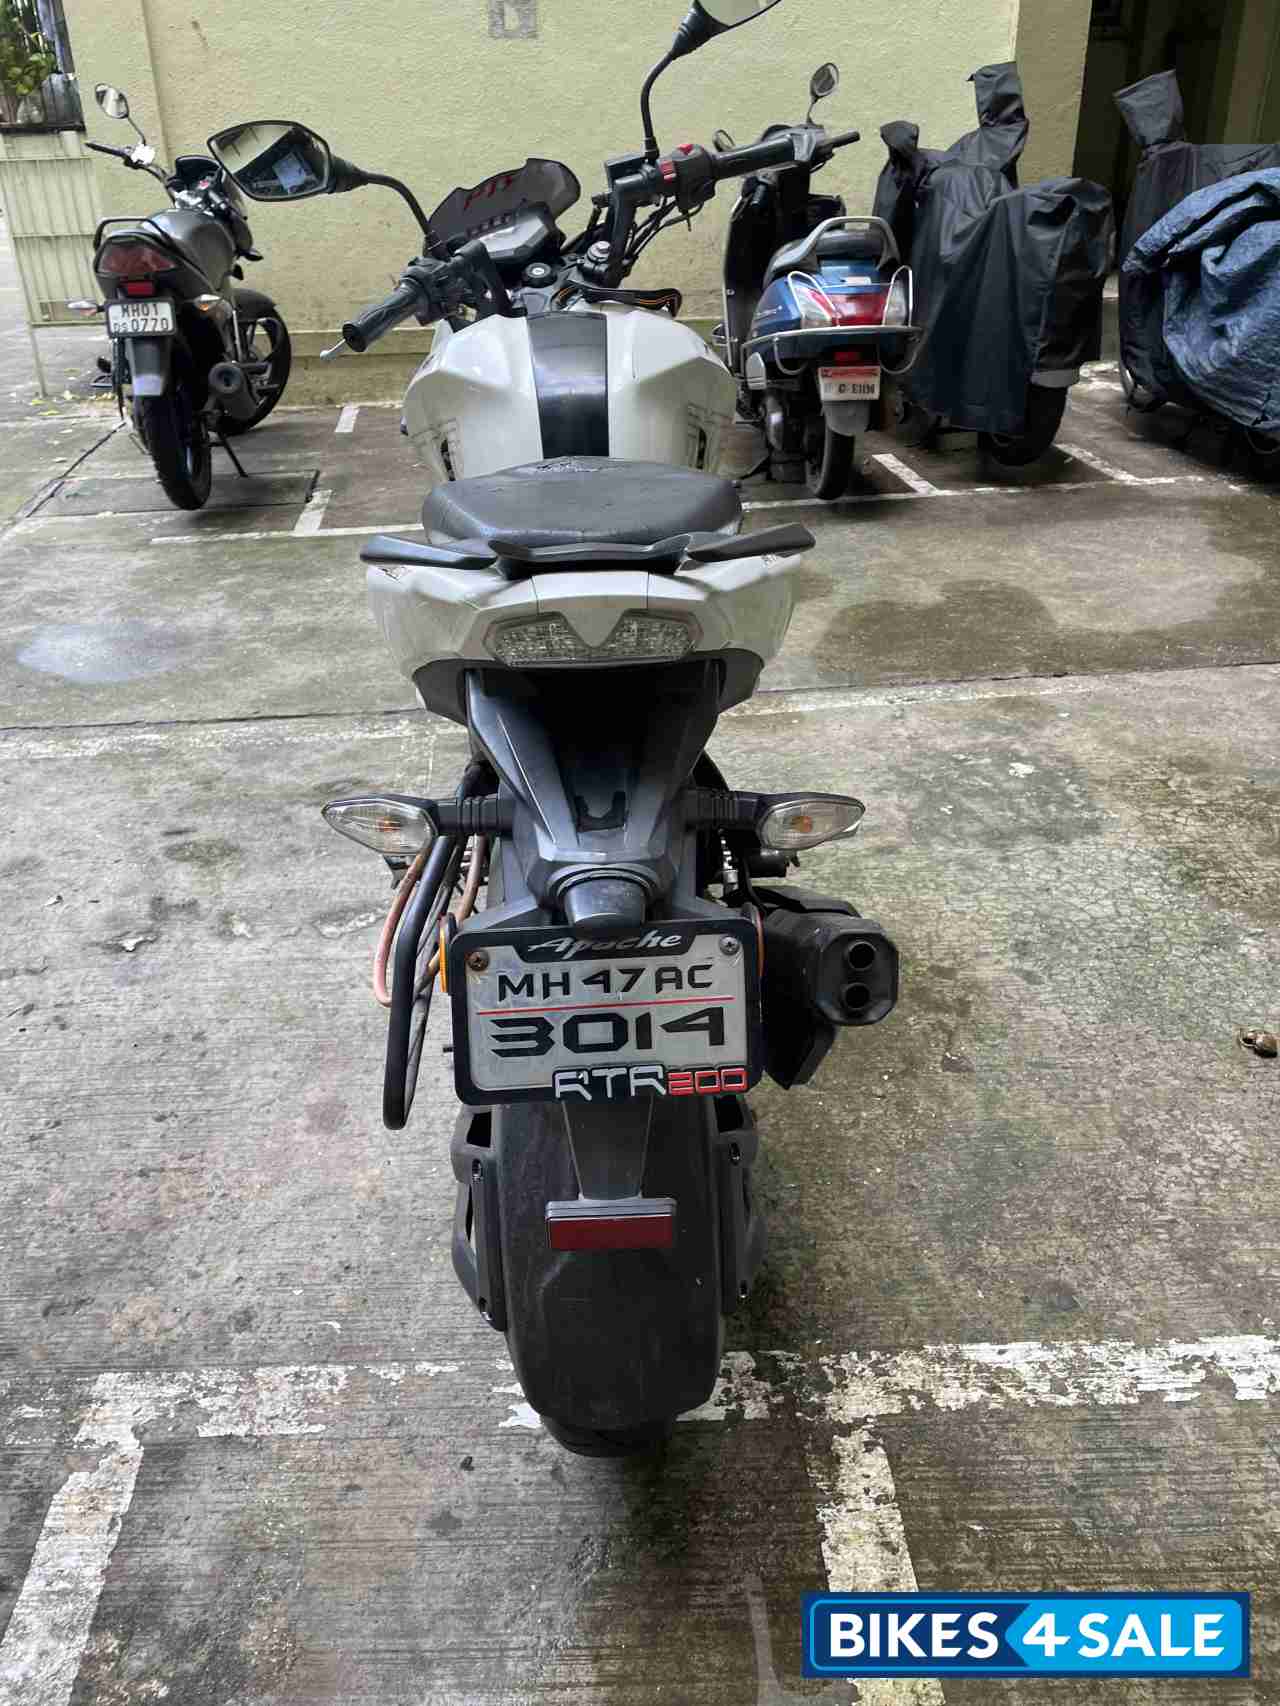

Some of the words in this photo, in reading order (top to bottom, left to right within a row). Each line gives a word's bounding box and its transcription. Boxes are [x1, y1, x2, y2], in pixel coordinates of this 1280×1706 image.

[121, 303, 159, 317] MH01
[131, 317, 169, 332] 0770
[527, 929, 682, 959] Apache
[498, 971, 570, 1002] MH
[655, 964, 713, 994] AC
[490, 1006, 725, 1058] 3014
